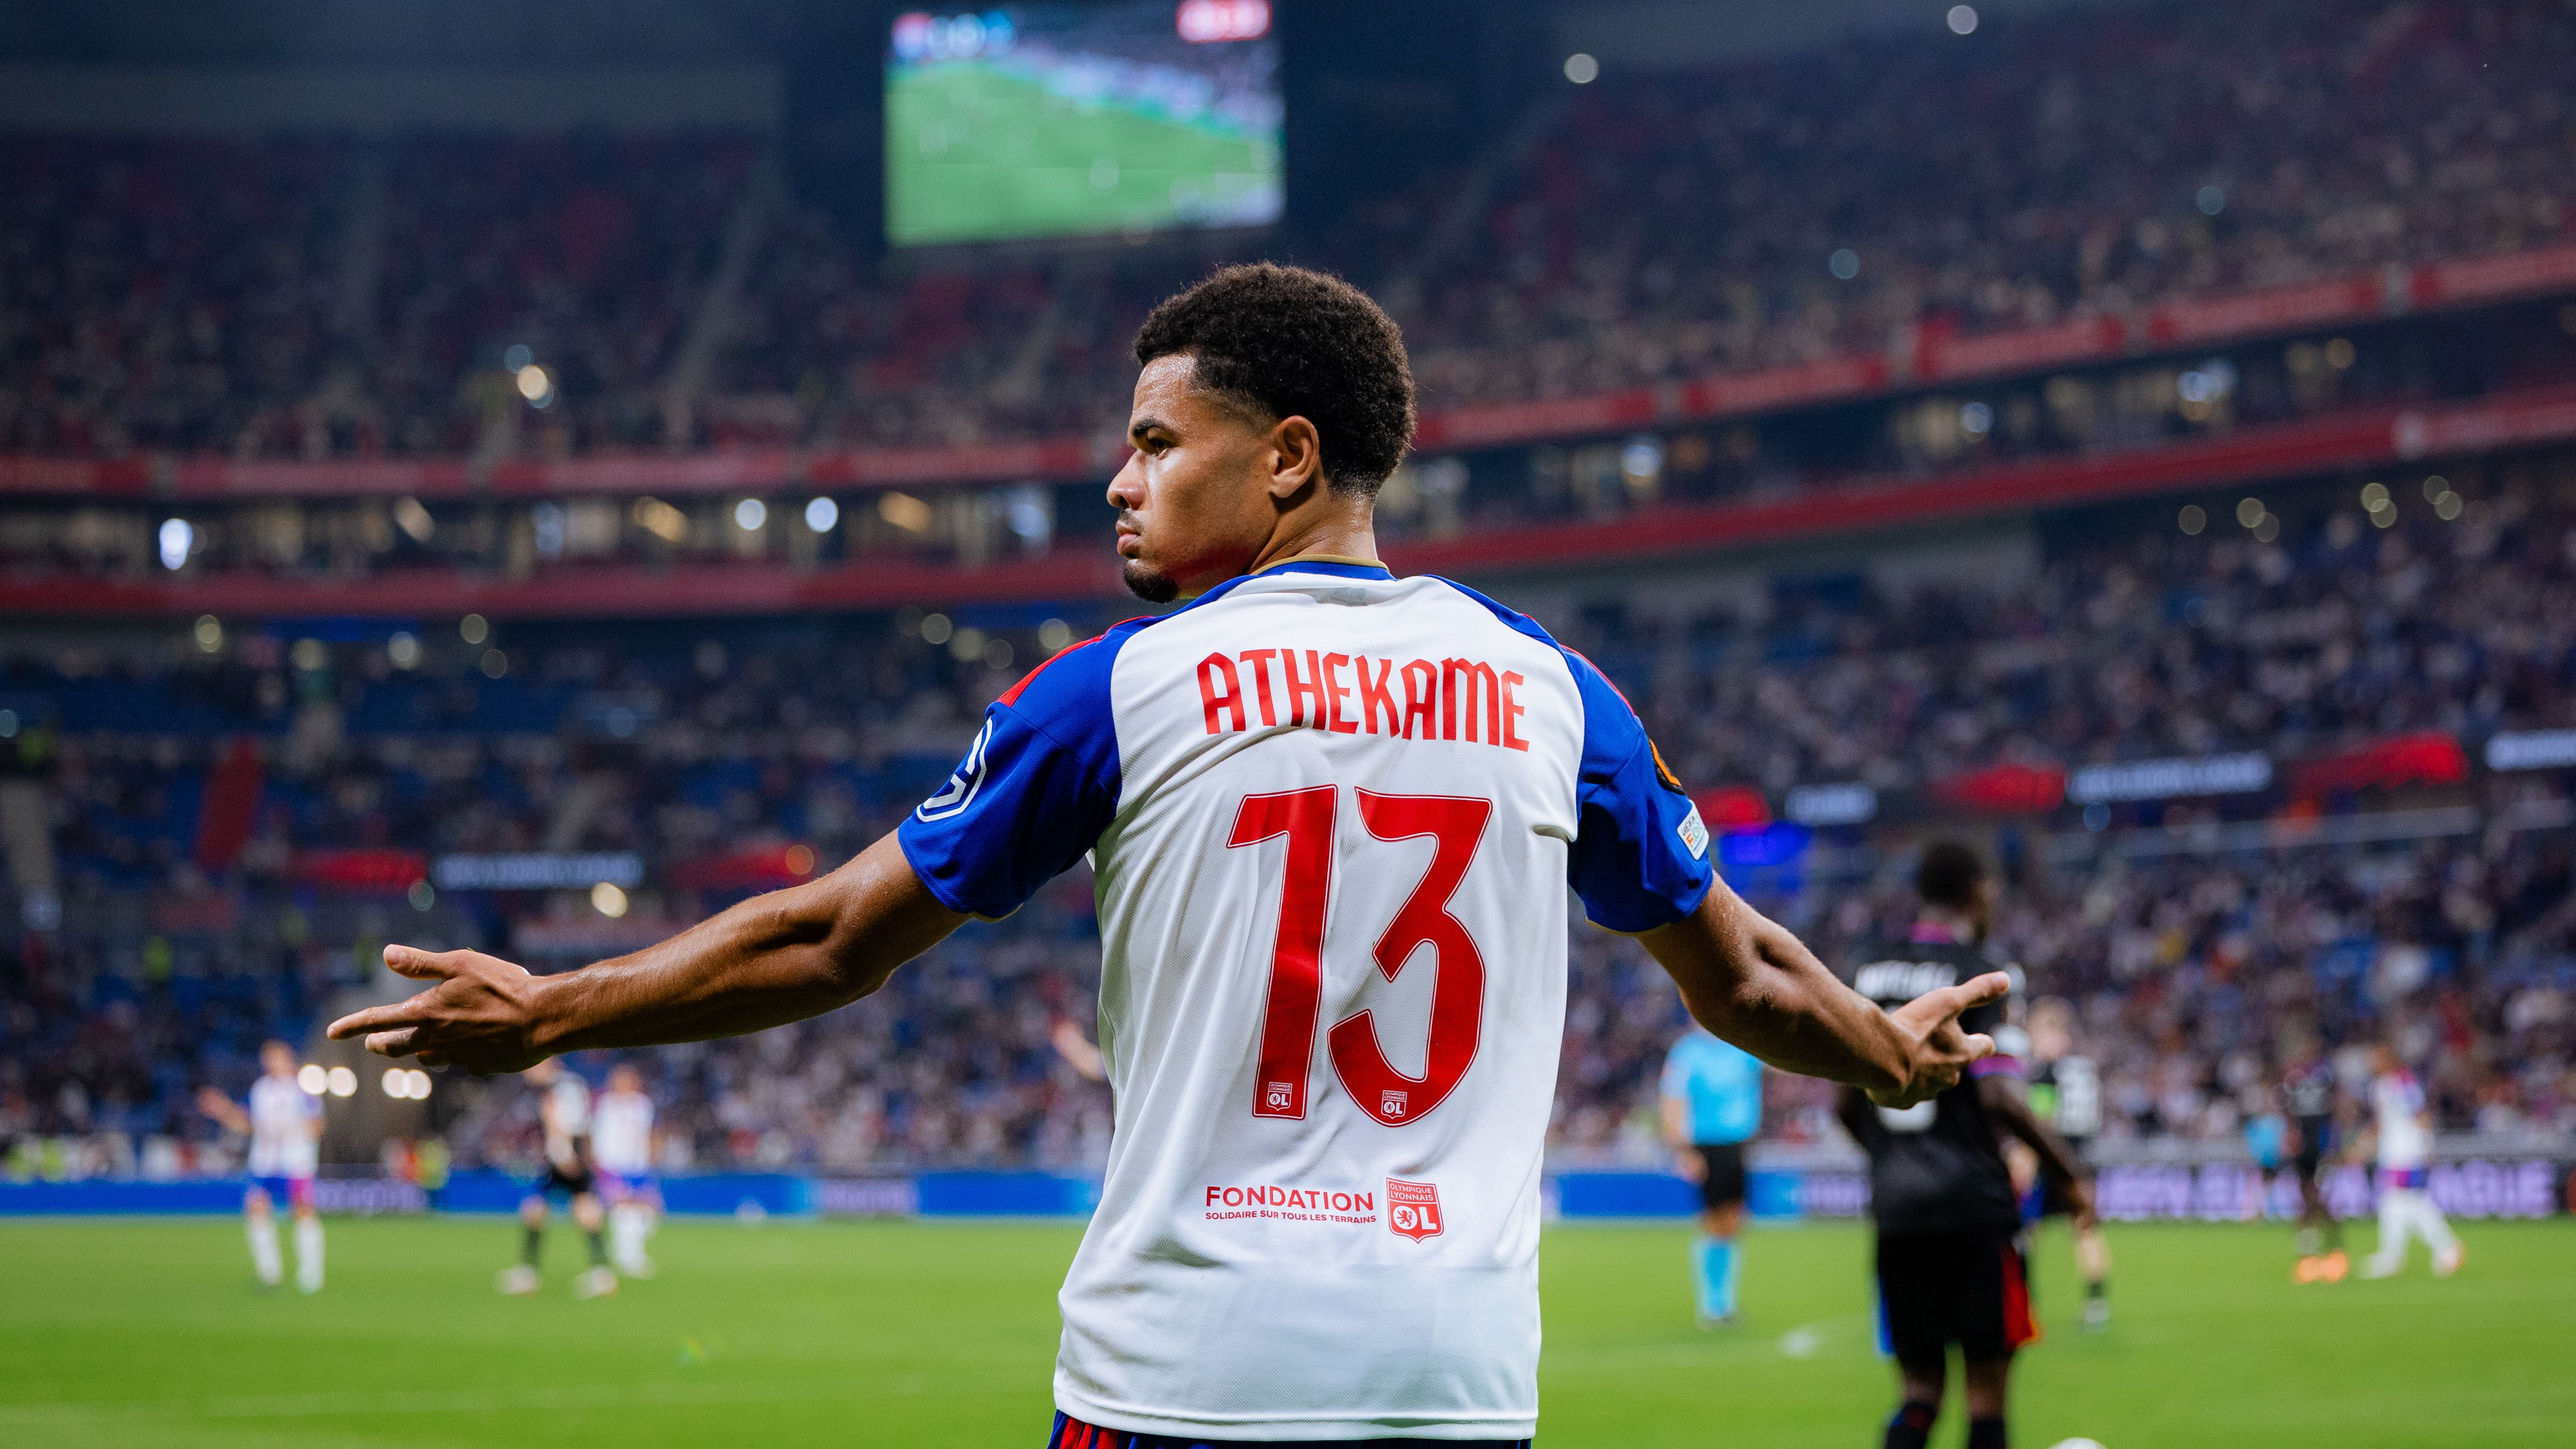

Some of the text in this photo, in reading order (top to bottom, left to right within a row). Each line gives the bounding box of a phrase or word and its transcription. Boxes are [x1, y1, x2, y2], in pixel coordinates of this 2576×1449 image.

[1197, 648, 1529, 752] ATHEKAME
[1226, 783, 1493, 1128] 13
[1269, 1093, 1288, 1106] OL
[1384, 1102, 1403, 1114] OL
[1390, 1183, 1432, 1194] OLYMPIQUE
[1206, 1186, 1373, 1212] FONDATION
[1390, 1191, 1434, 1201] LYONNAIS
[1206, 1211, 1257, 1220] SOLIDAIRE
[1260, 1210, 1279, 1219] SUR
[1330, 1215, 1376, 1224] TERRAINS
[1393, 1205, 1437, 1230] OL
